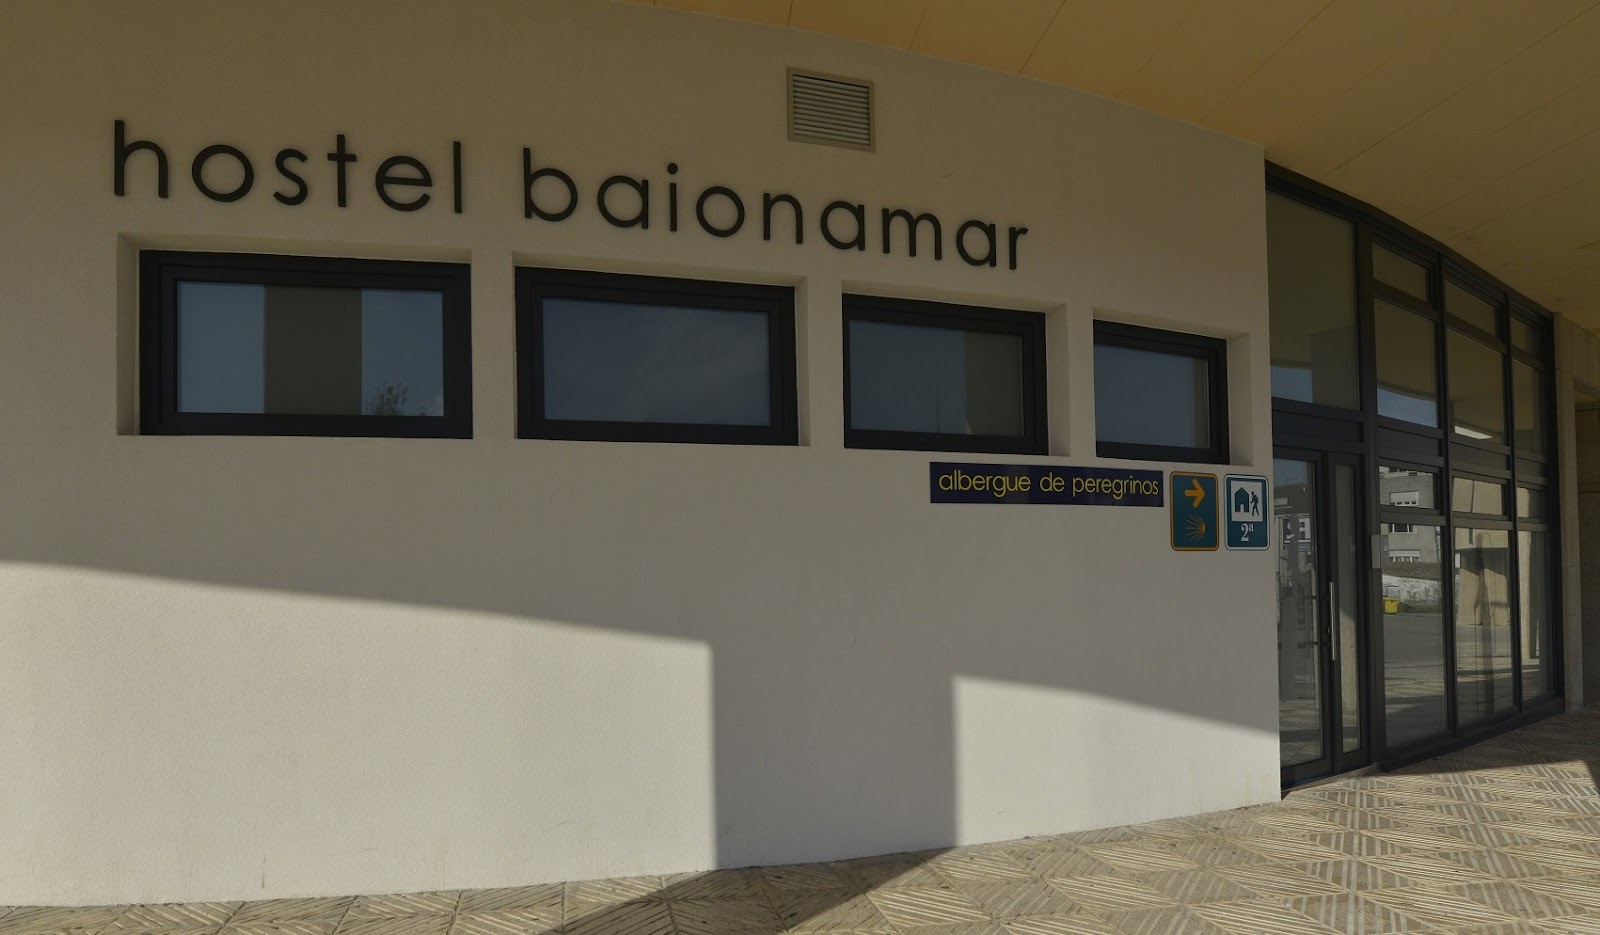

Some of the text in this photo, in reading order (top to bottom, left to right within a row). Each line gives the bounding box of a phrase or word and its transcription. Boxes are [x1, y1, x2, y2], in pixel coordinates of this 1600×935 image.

[114, 120, 1030, 271] hostel baionamar
[938, 469, 1159, 500] albergue de peregrinos
